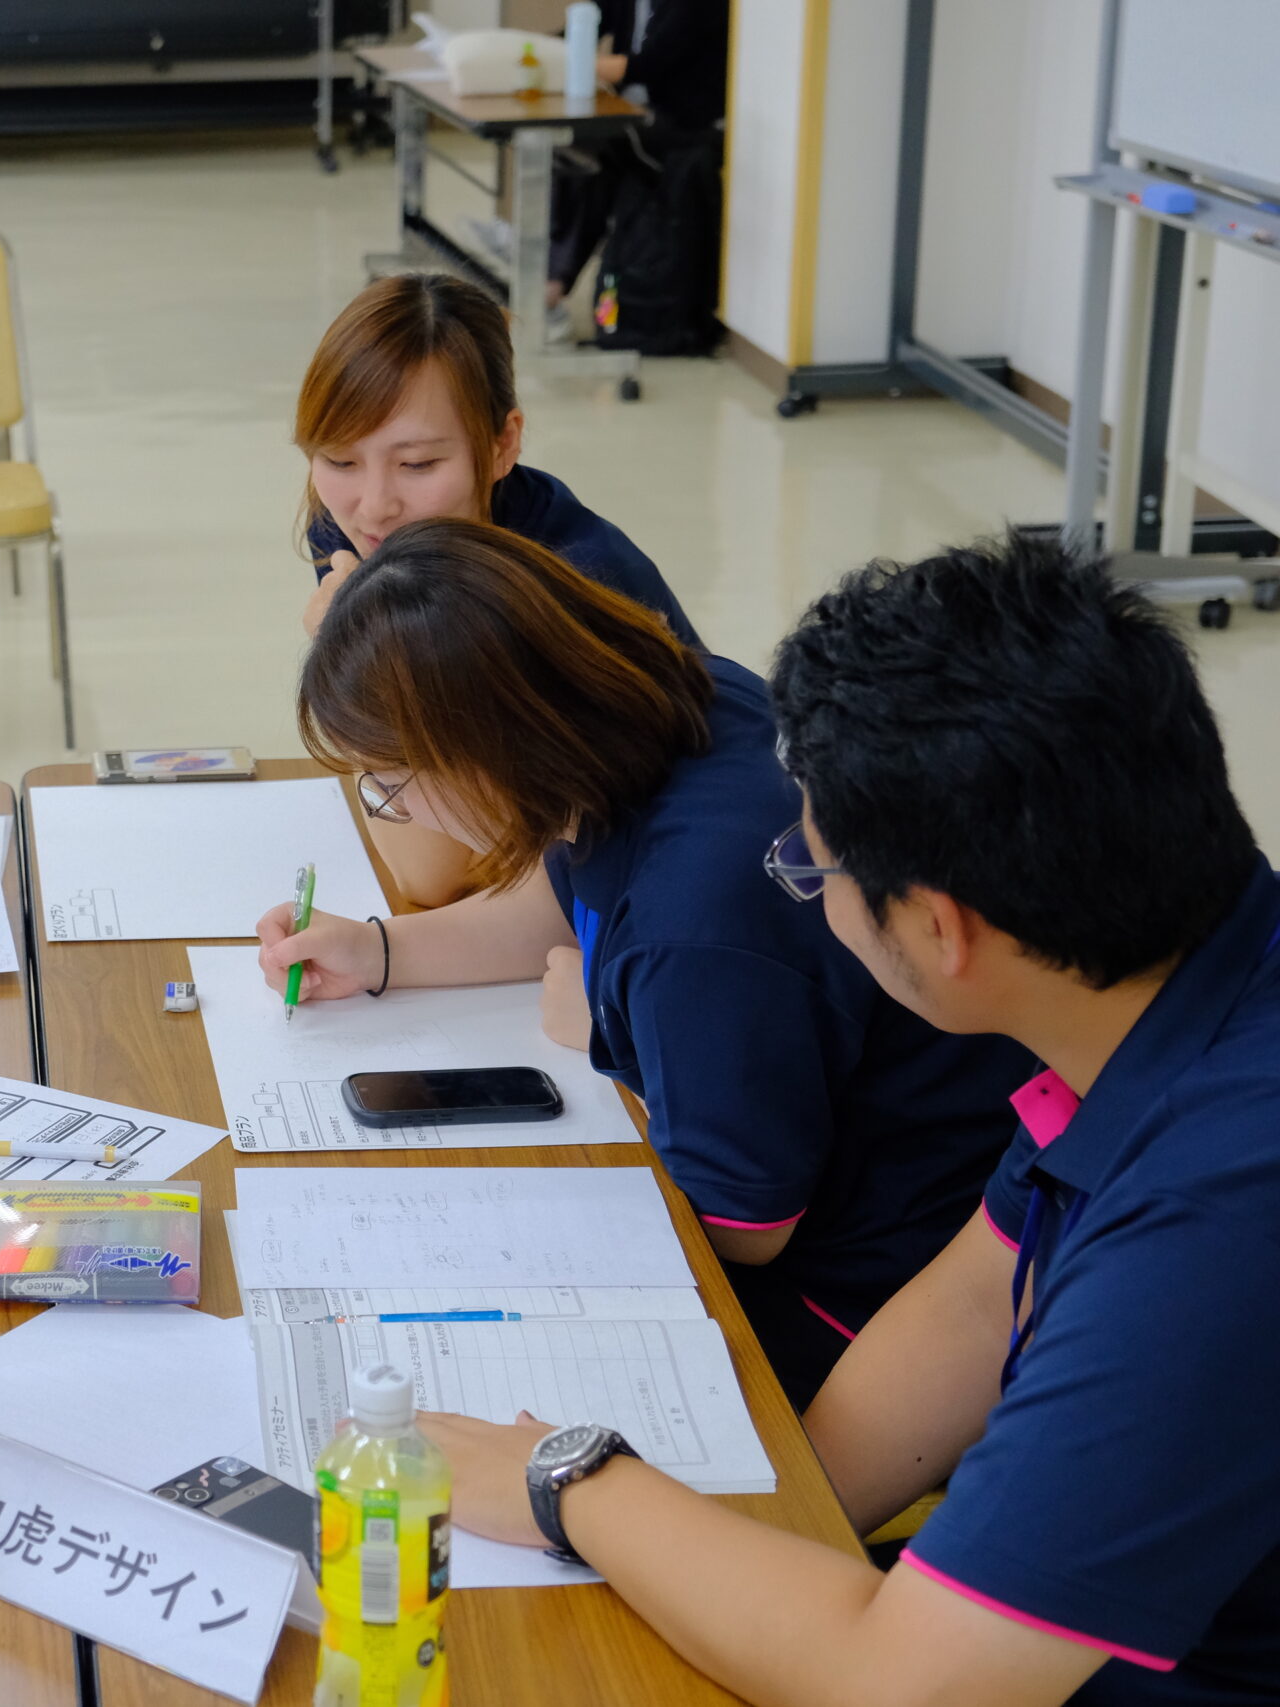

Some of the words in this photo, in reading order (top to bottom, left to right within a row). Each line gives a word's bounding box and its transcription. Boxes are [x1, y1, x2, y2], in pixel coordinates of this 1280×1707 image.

[235, 1115, 257, 1148] 商品プラン
[25, 1281, 64, 1291] Mckee
[271, 1394, 292, 1467] アクティブセミナー
